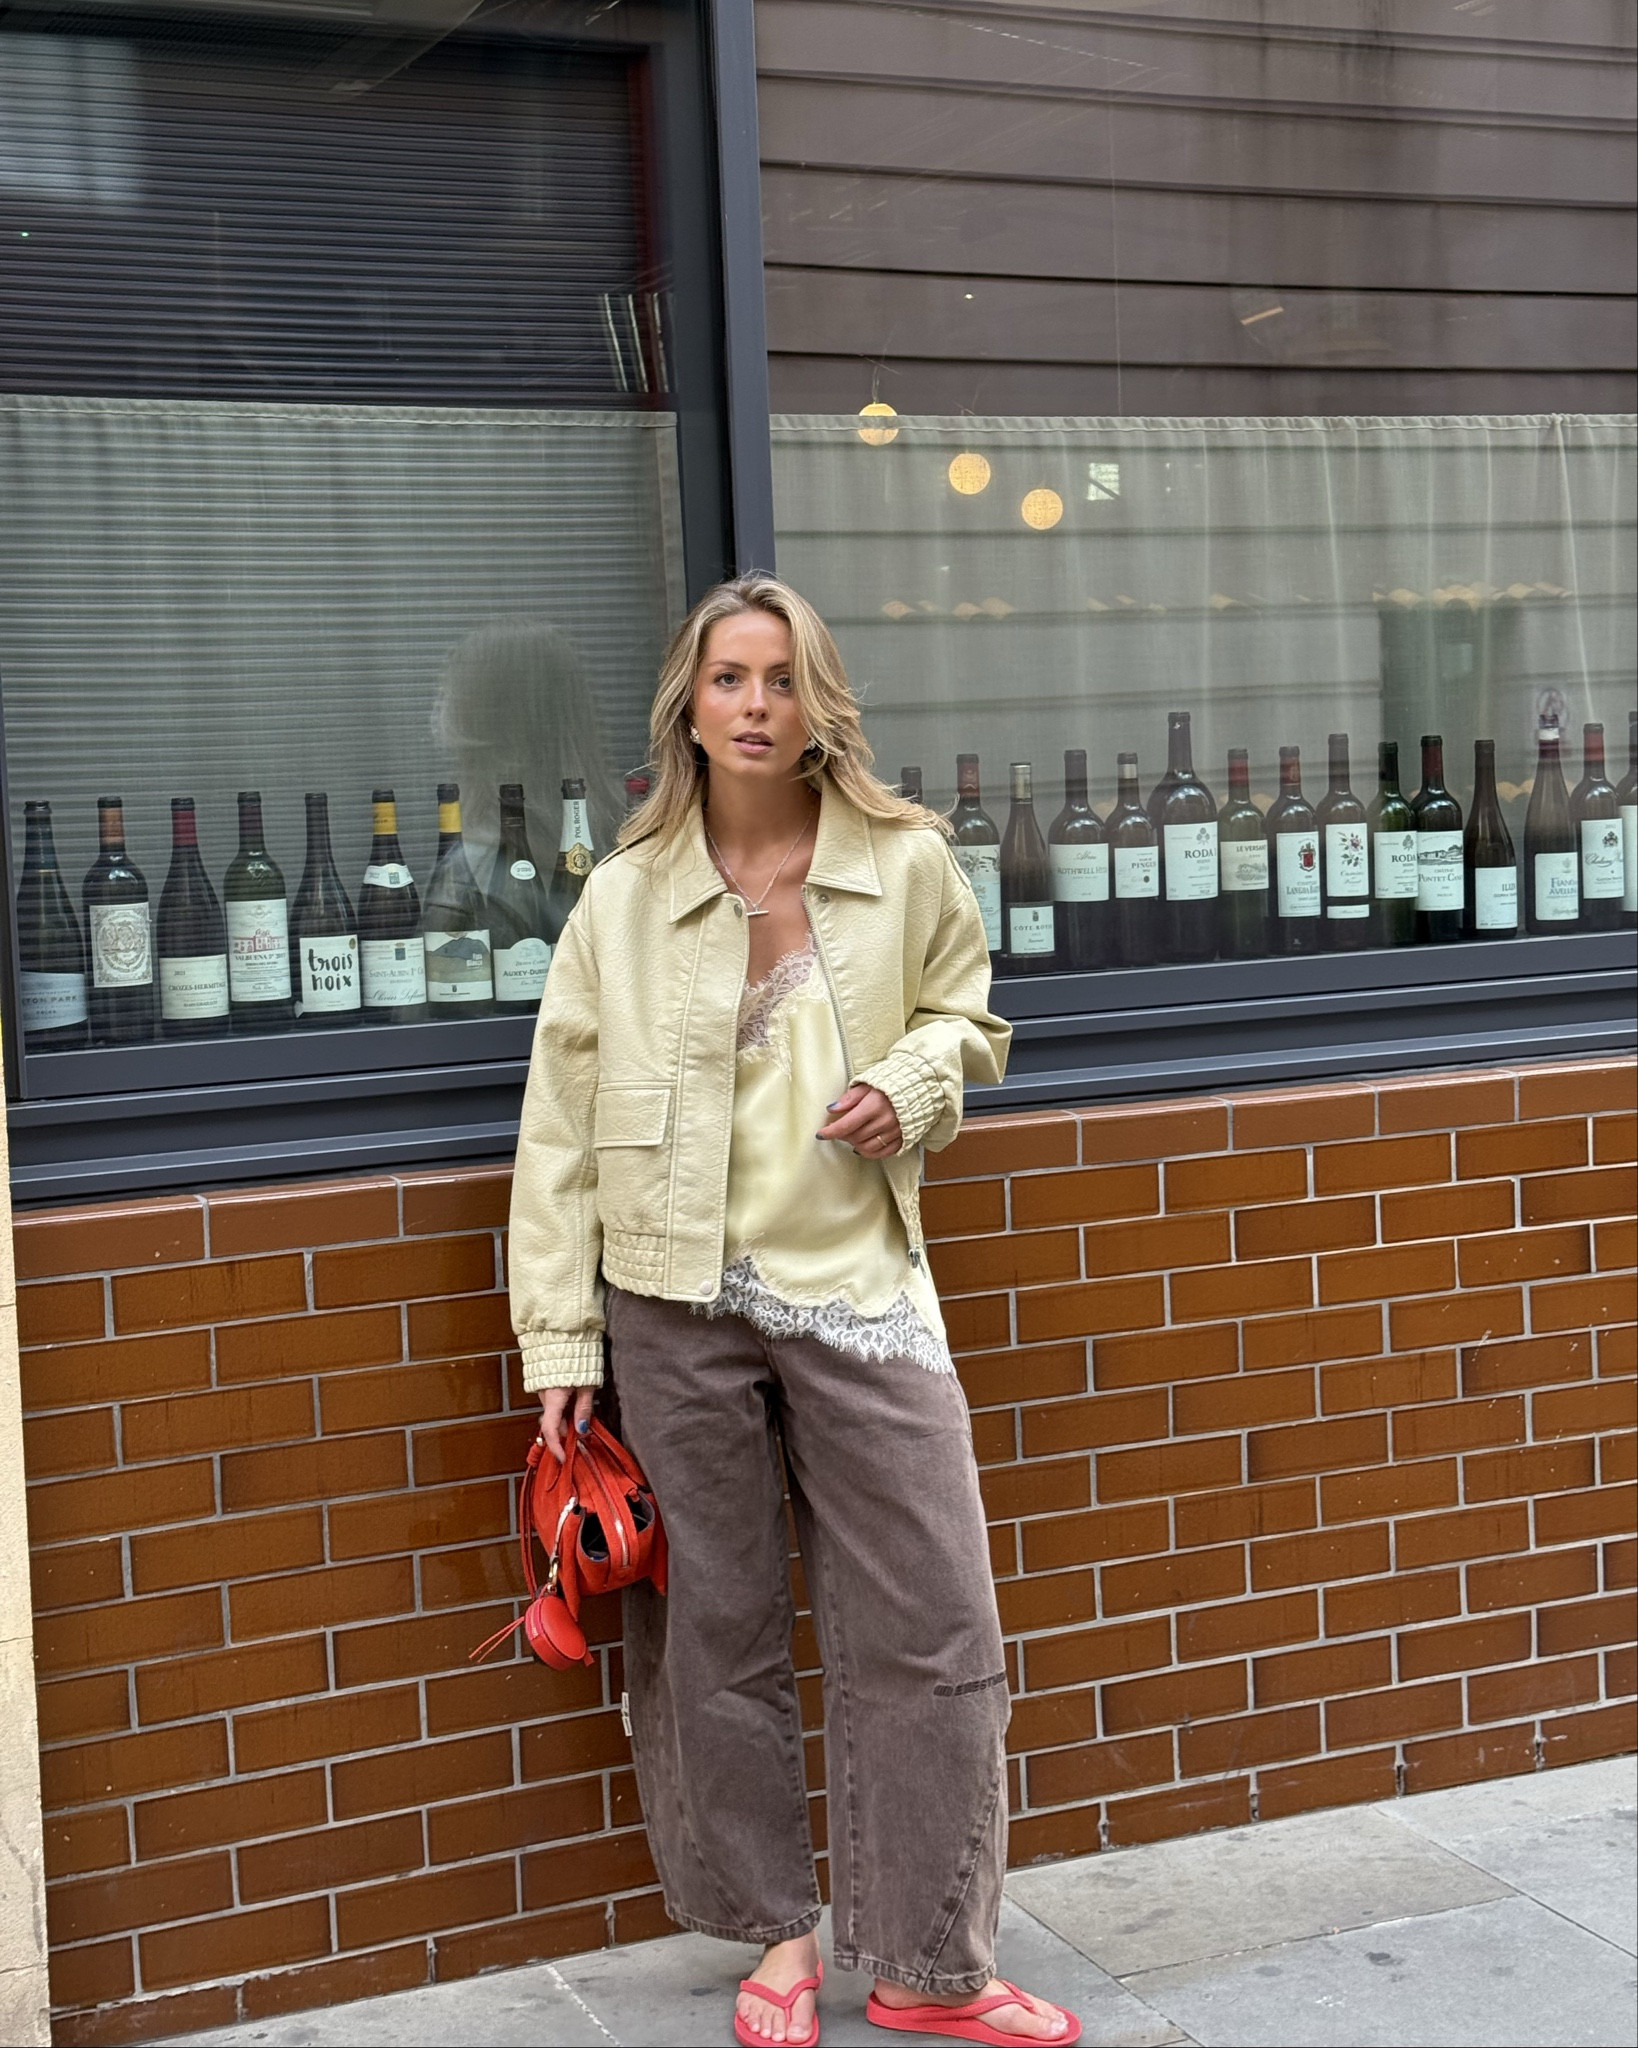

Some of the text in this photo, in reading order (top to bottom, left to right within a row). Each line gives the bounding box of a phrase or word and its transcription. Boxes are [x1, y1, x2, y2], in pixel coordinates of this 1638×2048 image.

[572, 800, 582, 839] POL ROGER
[1184, 848, 1213, 859] RODA
[1391, 853, 1417, 863] RODA
[307, 947, 353, 972] trois
[311, 973, 353, 992] noix
[50, 994, 78, 1004] PARK
